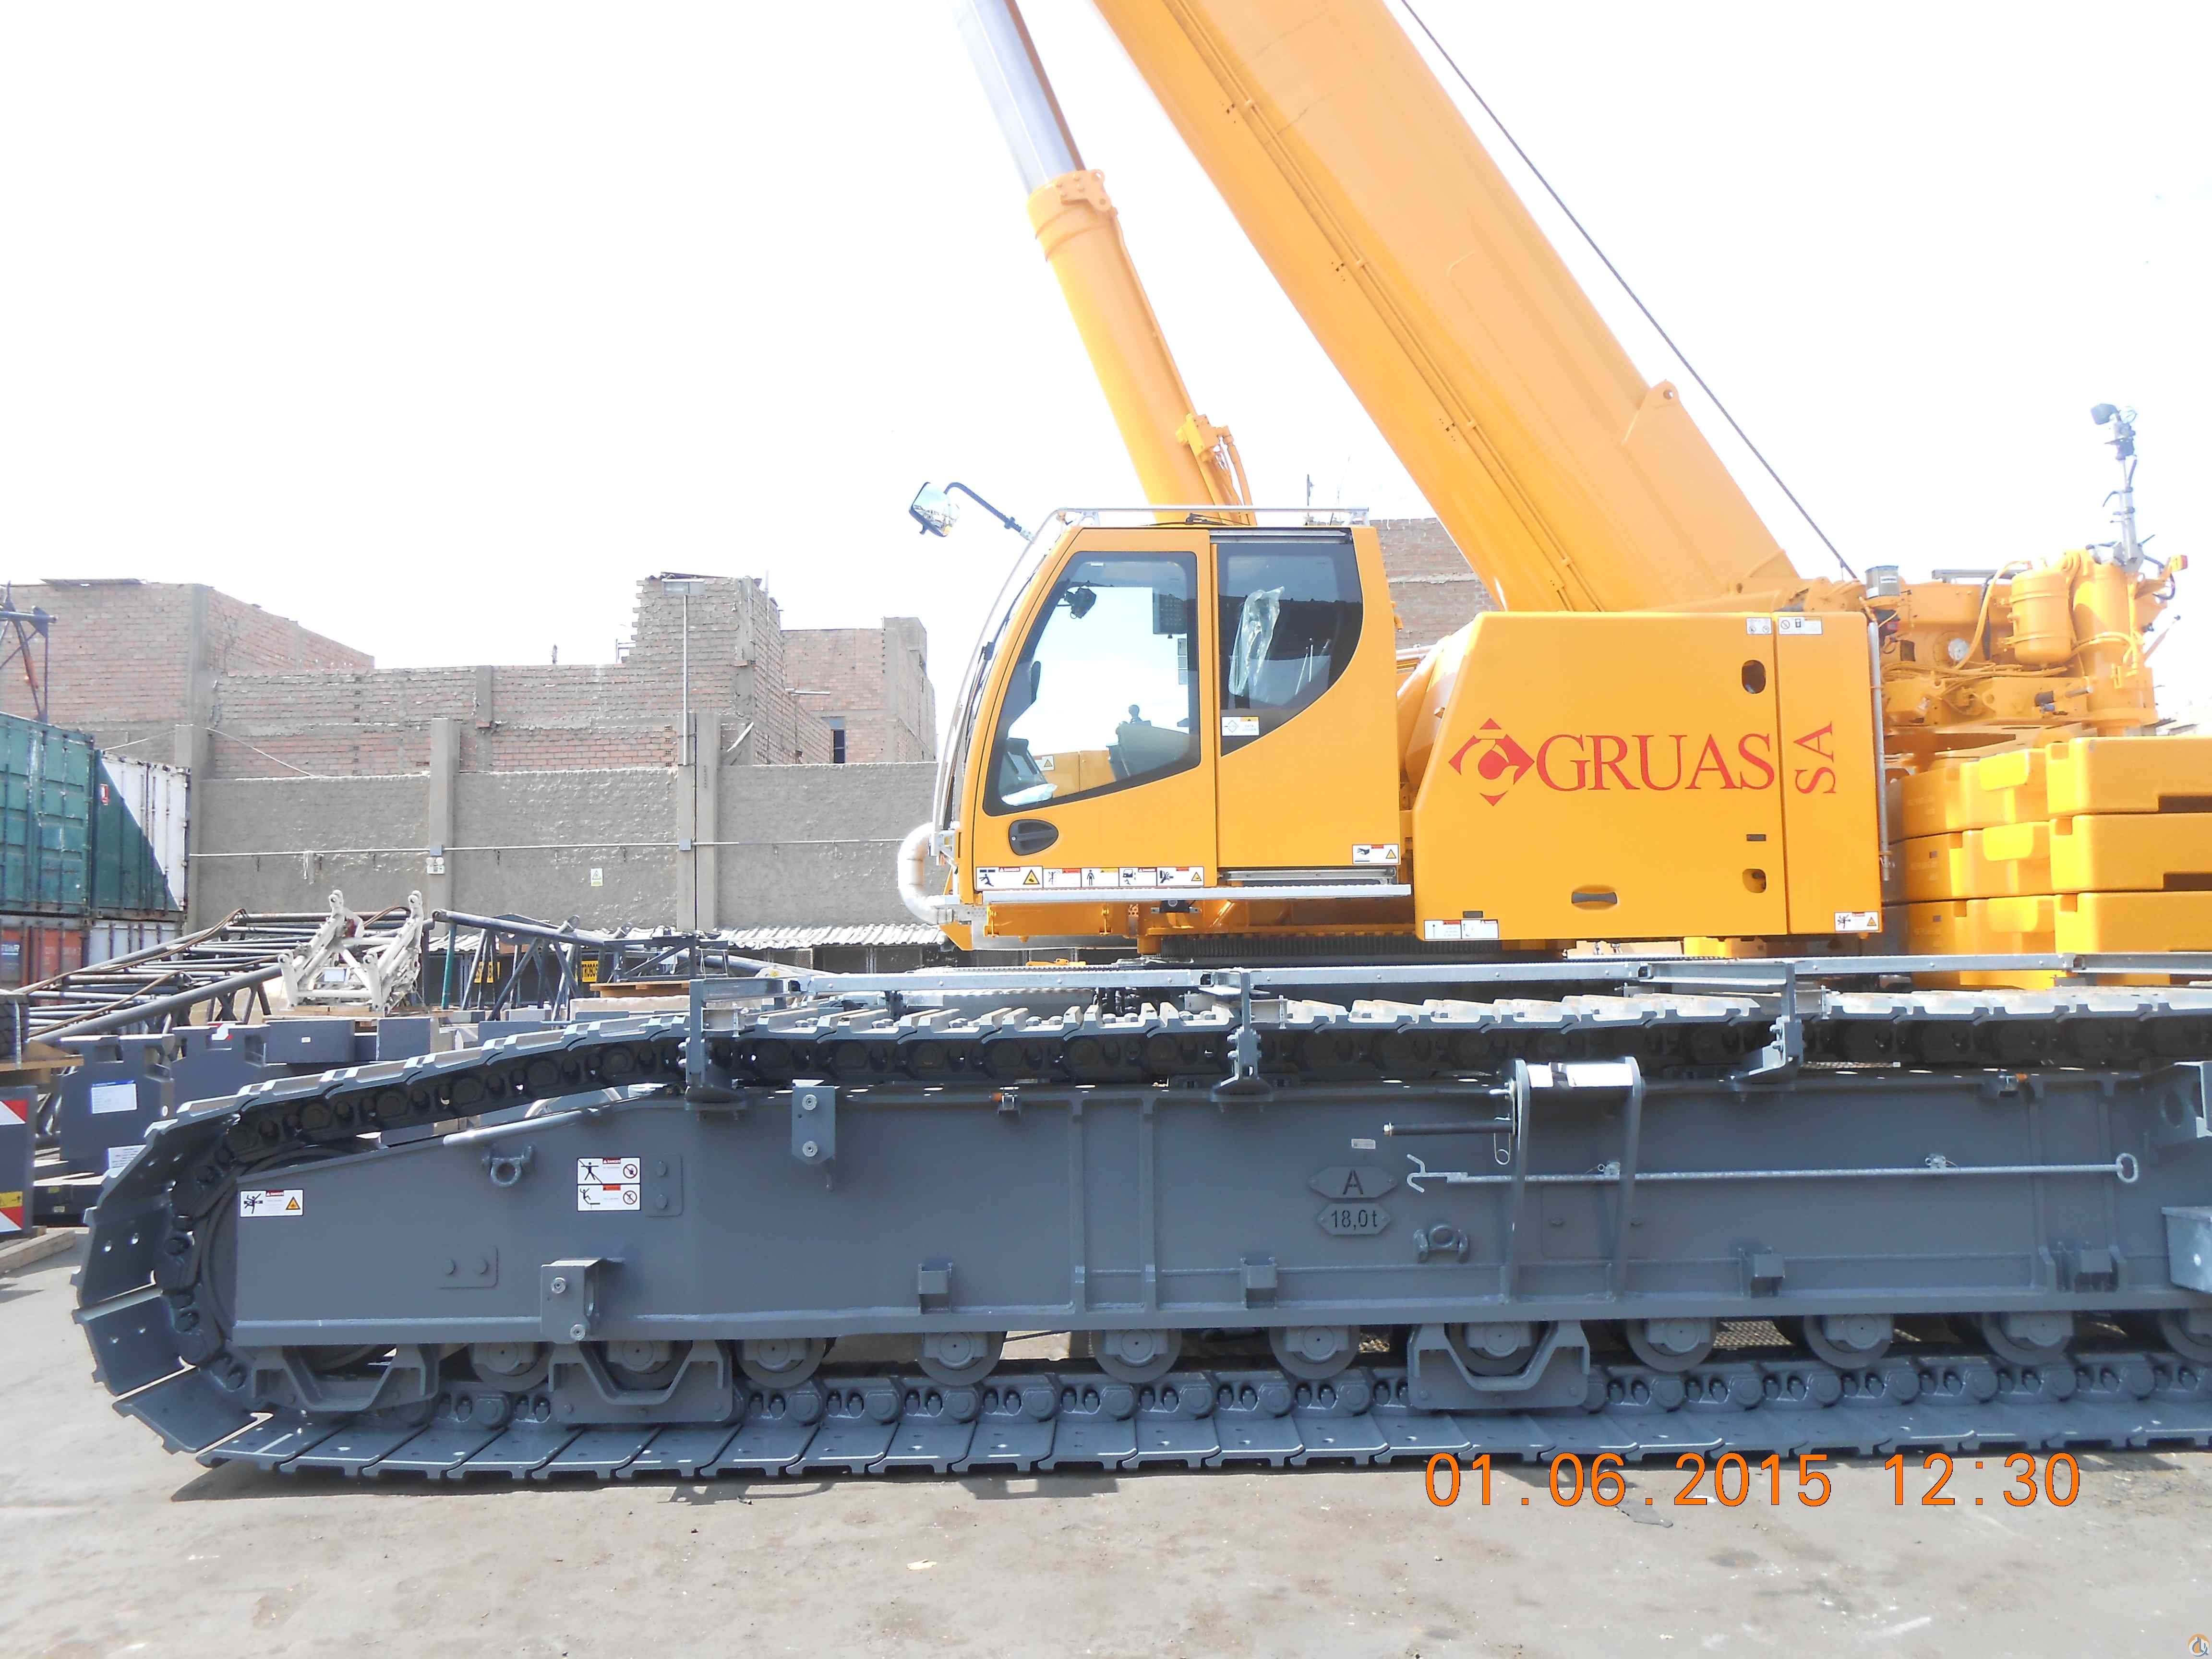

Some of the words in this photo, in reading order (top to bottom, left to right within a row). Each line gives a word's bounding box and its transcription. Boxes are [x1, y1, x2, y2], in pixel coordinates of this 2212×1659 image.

[1536, 734, 1775, 791] GRUAS
[1793, 721, 1837, 794] SA
[1343, 1169, 1363, 1195] A
